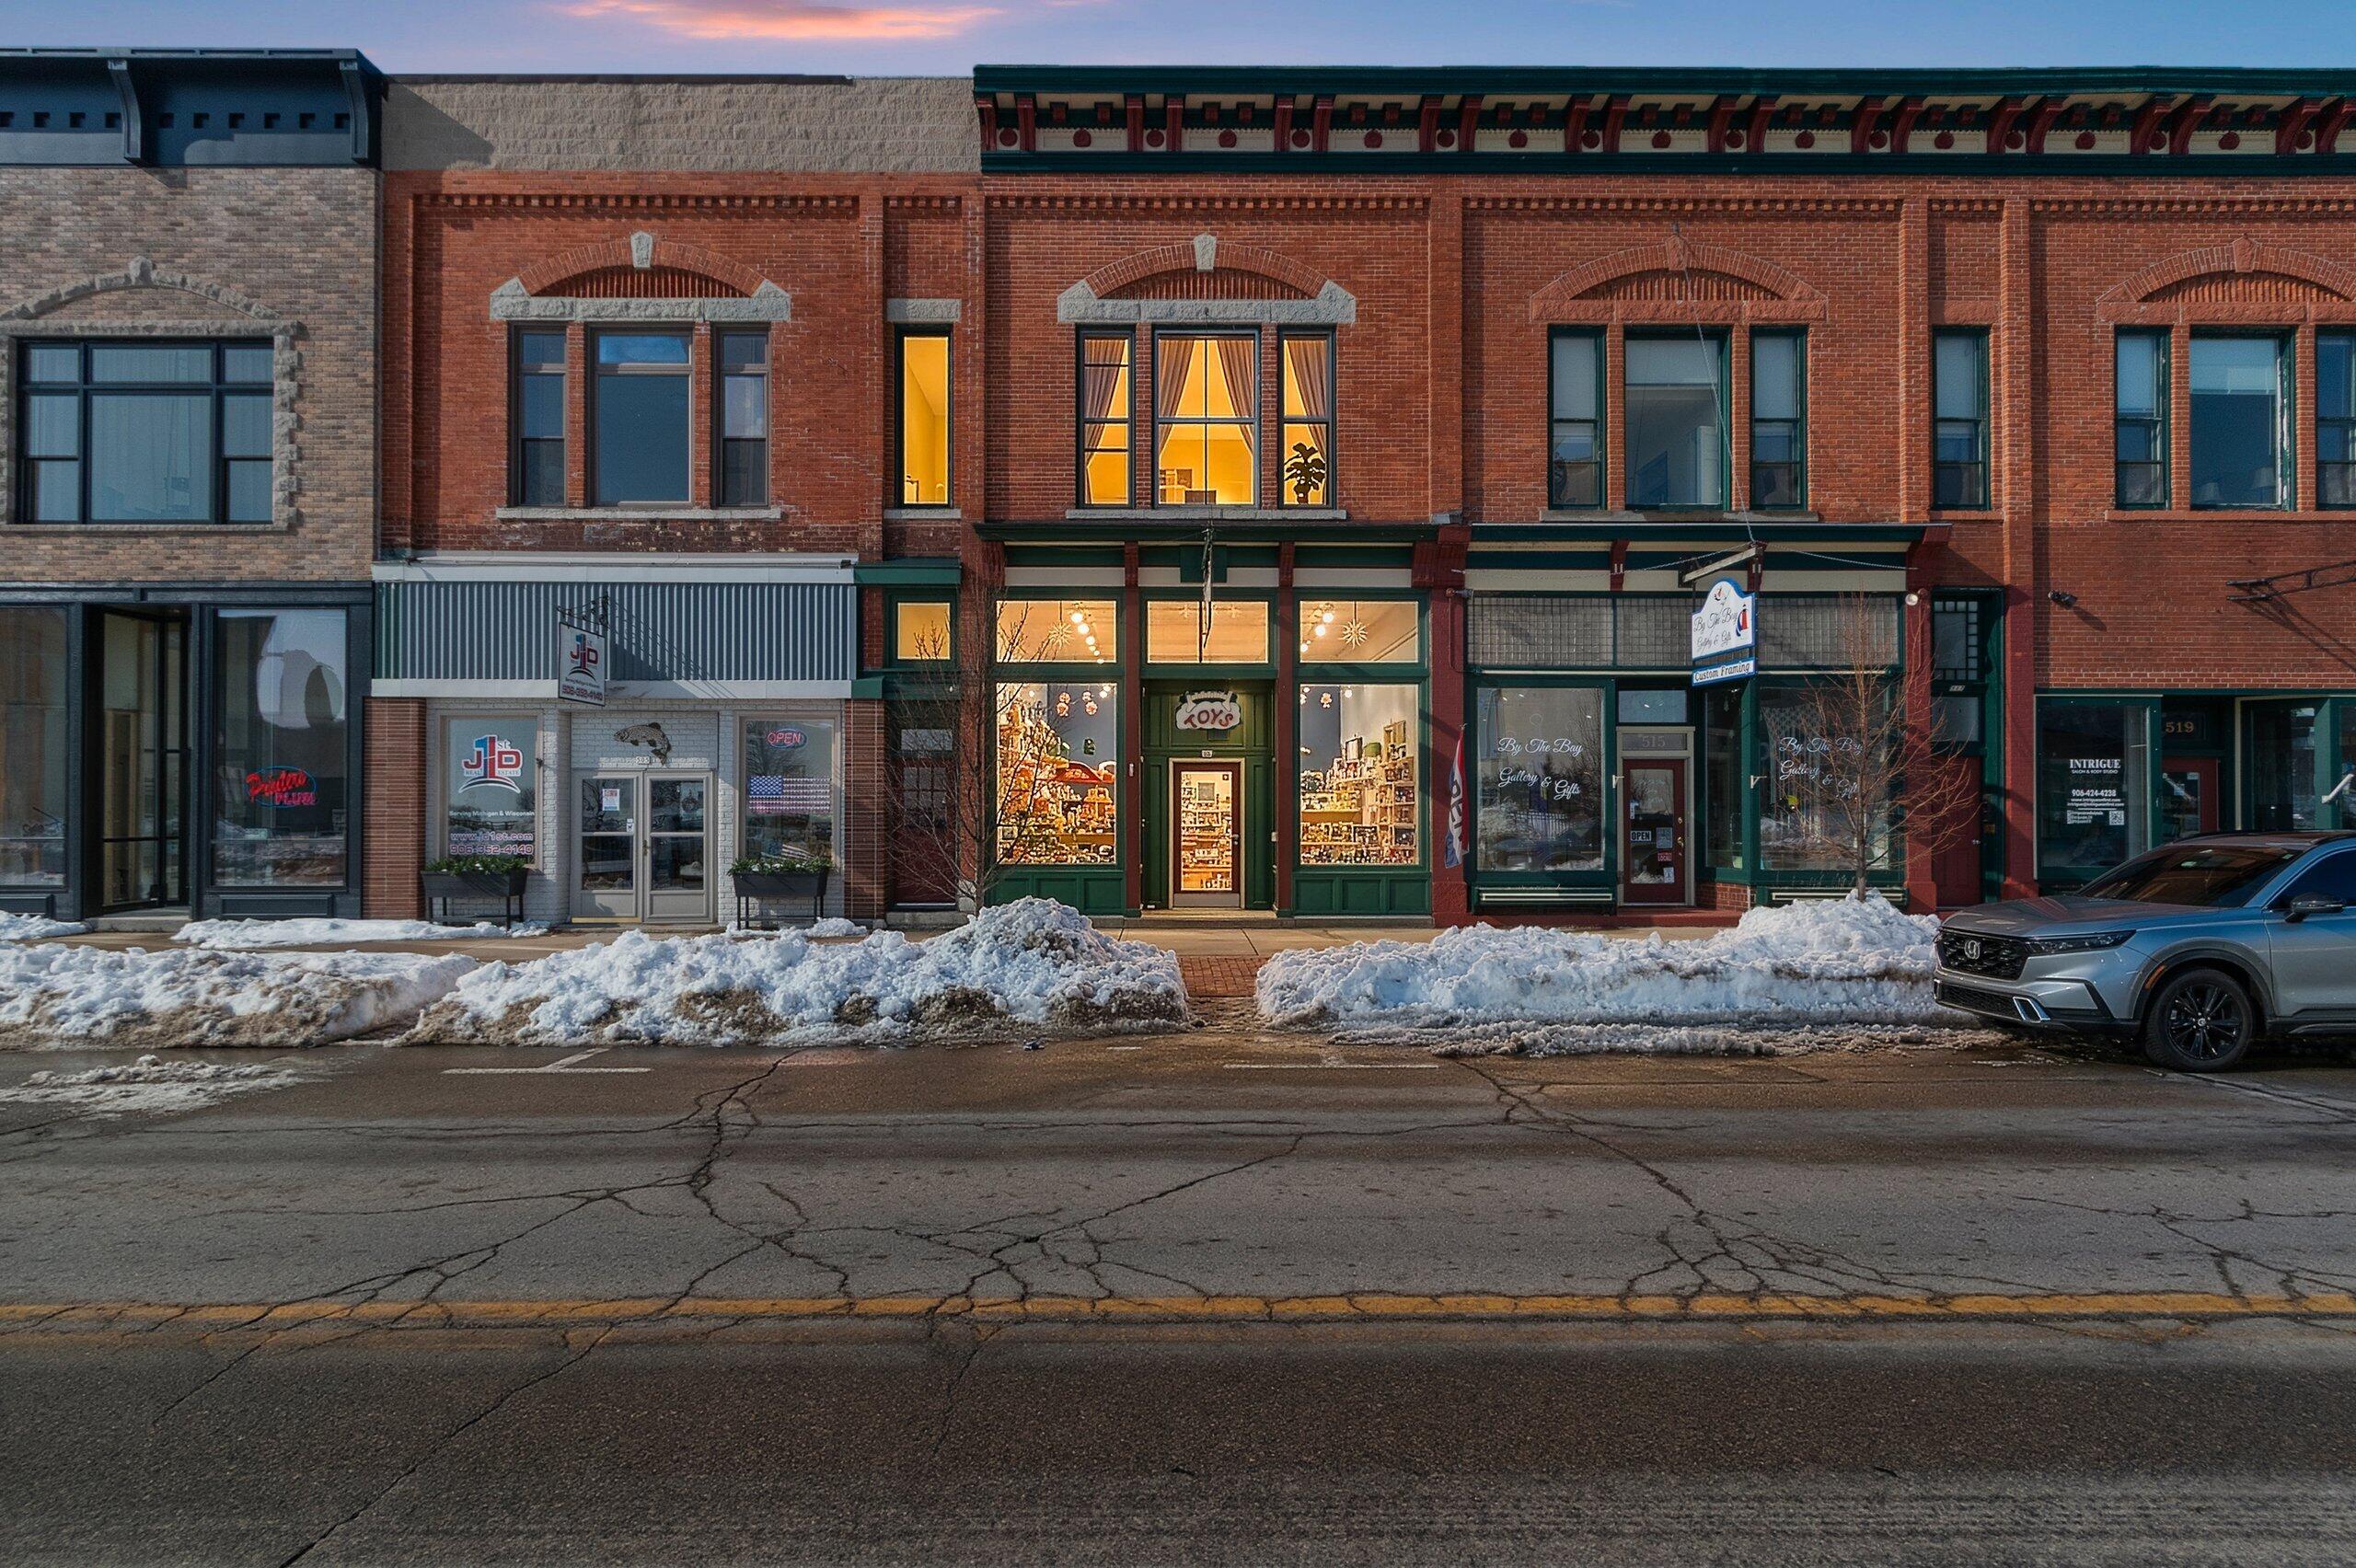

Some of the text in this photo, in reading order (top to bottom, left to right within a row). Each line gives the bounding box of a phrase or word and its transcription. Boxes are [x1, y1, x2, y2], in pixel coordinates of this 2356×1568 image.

[1694, 663, 1750, 681] Custom Framing
[1184, 709, 1234, 728] TOYS
[2165, 721, 2195, 733] 519
[768, 732, 801, 744] OPEN
[1642, 736, 1666, 748] 515
[1497, 737, 1583, 756] By The Bay
[1779, 737, 1804, 756] By
[2069, 758, 2121, 769] INTRIGUE
[1497, 767, 1539, 788] Gallery
[1541, 776, 1553, 788] &
[1553, 779, 1581, 801] Gifts
[1631, 831, 1650, 841] OPEN
[449, 844, 535, 855] 906-352-4140
